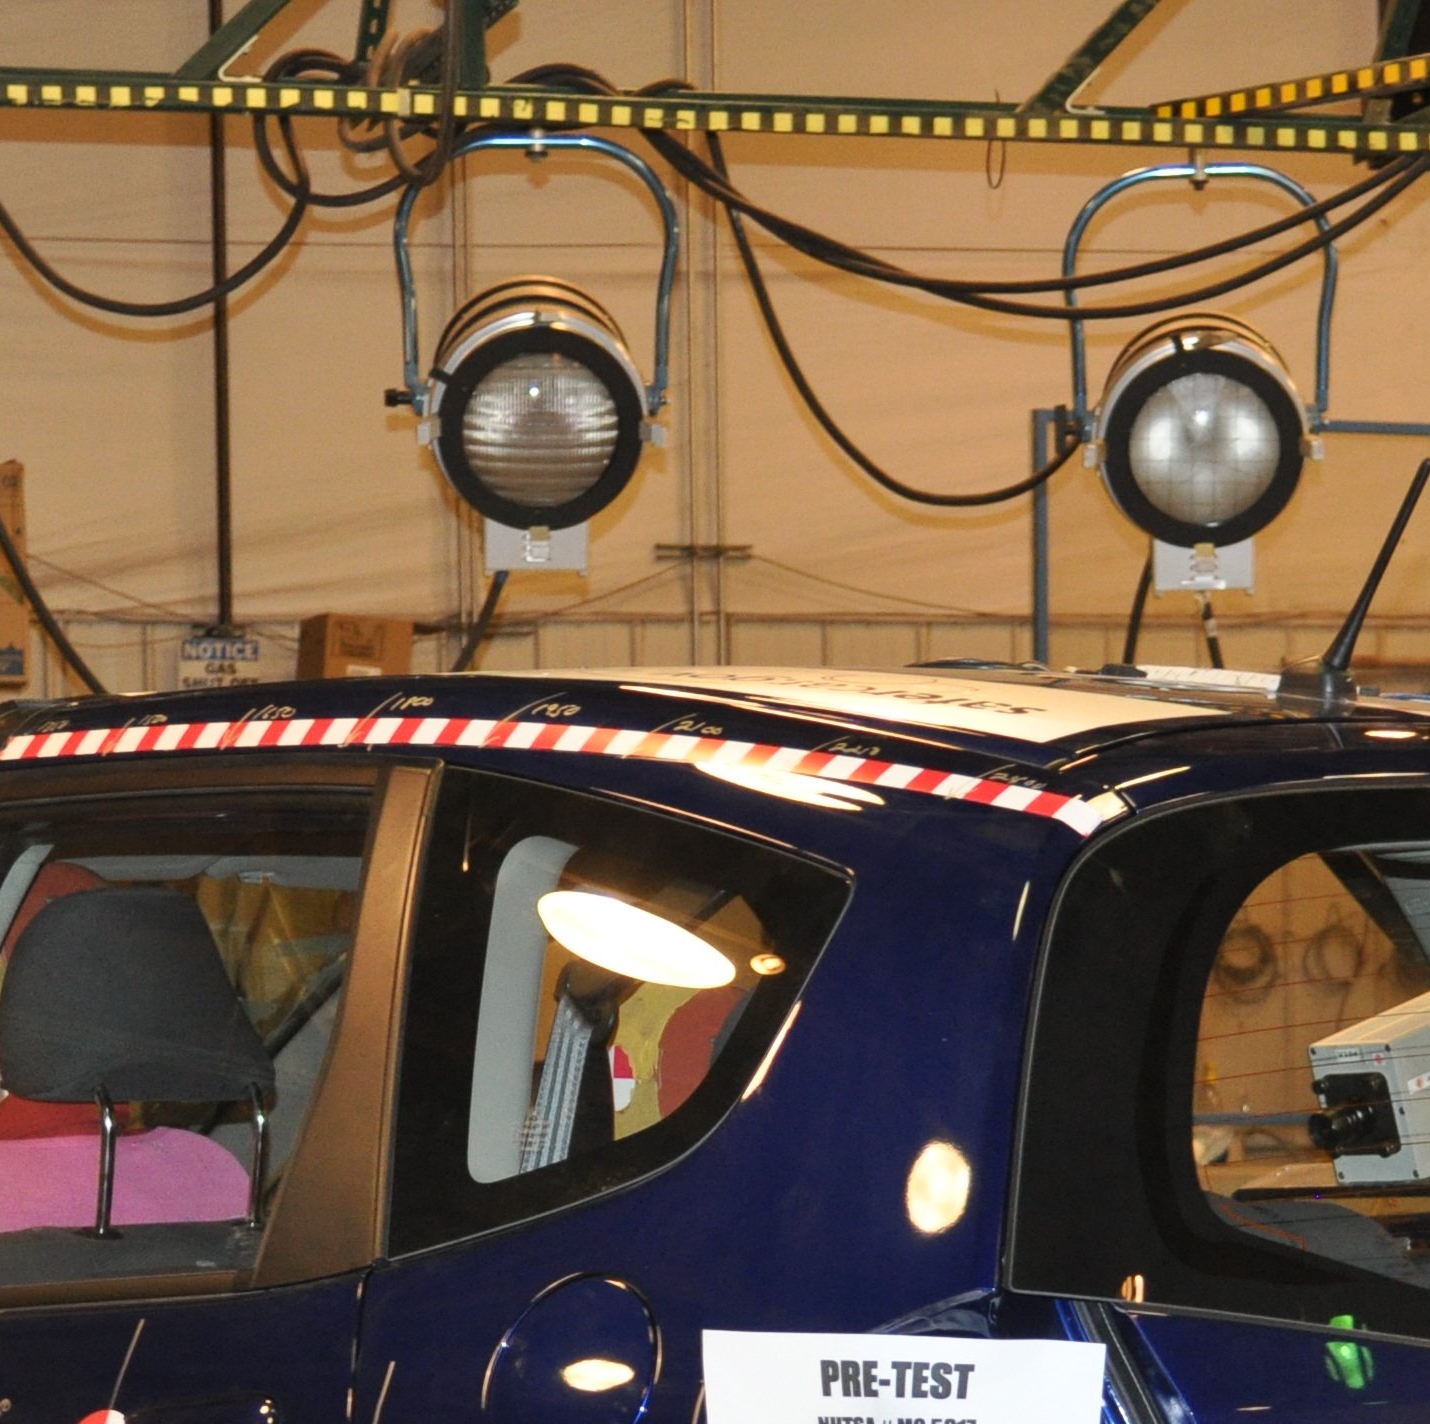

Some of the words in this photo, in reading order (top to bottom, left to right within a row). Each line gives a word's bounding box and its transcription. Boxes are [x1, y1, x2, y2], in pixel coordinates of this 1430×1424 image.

[183, 640, 258, 659] NOTICE
[205, 663, 237, 675] GAS
[820, 1359, 975, 1400] PRE-TEST
